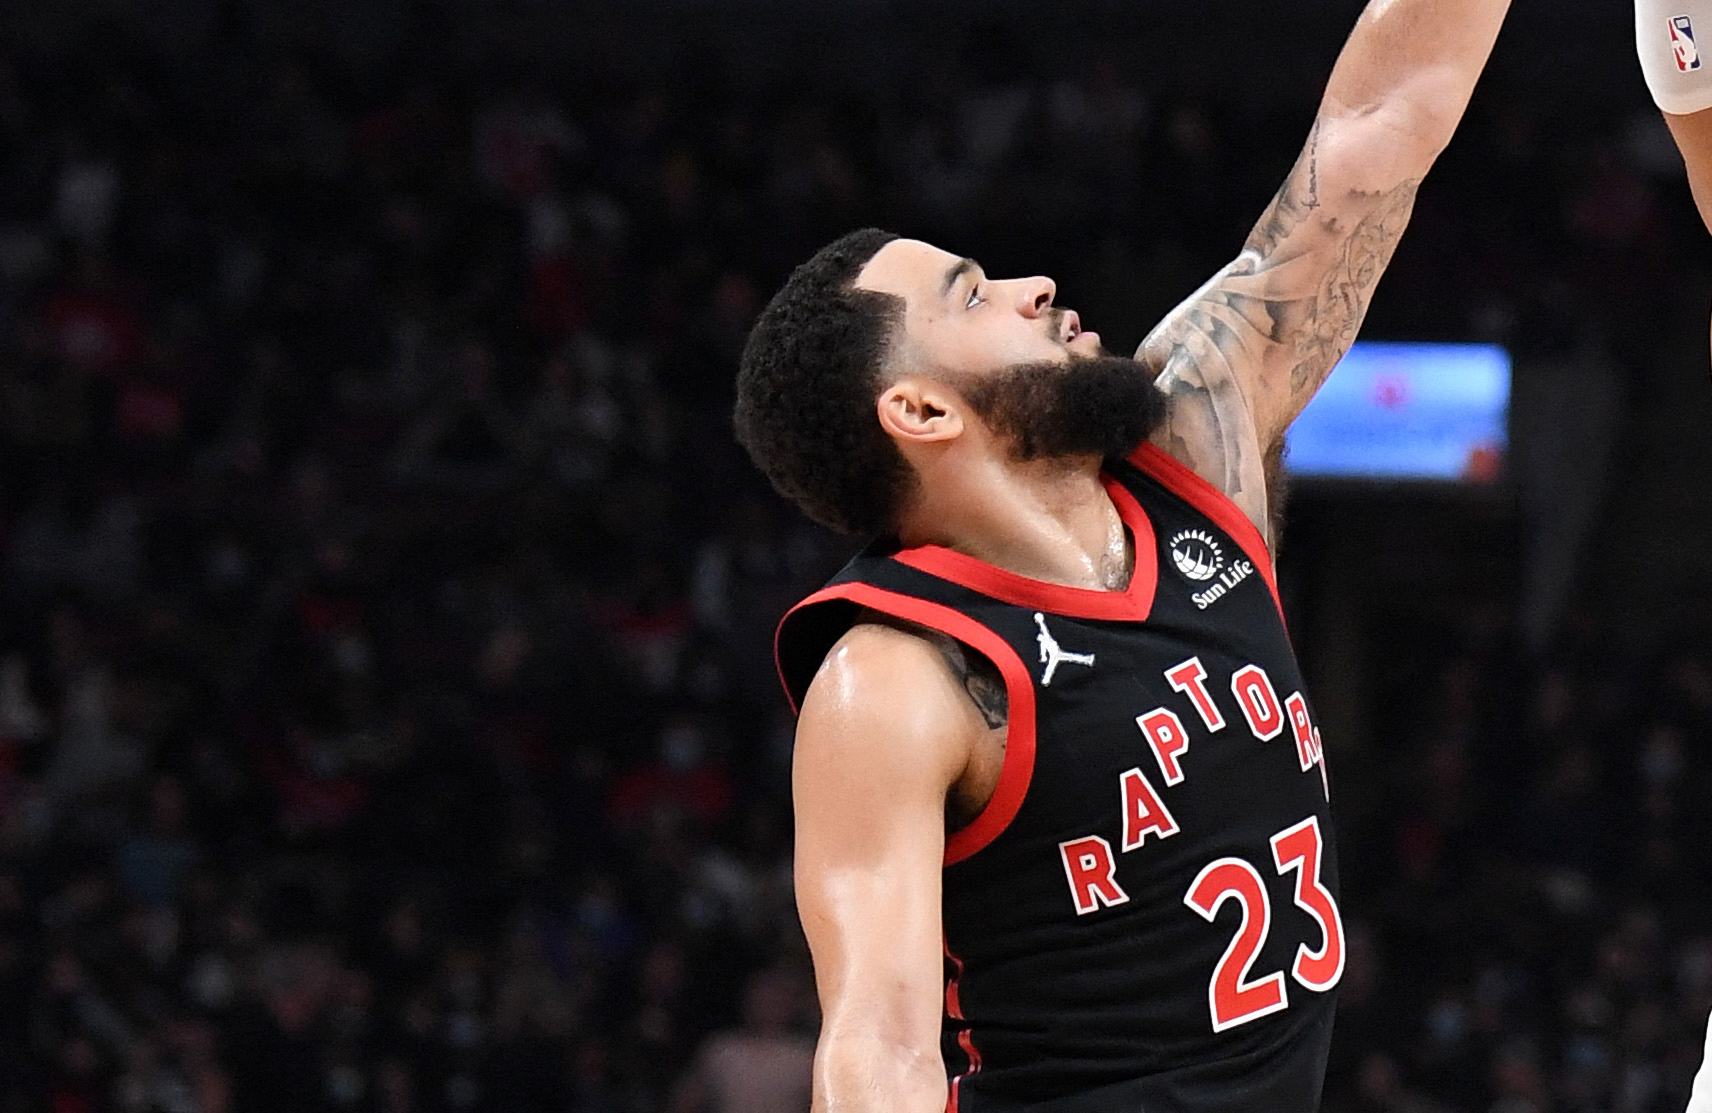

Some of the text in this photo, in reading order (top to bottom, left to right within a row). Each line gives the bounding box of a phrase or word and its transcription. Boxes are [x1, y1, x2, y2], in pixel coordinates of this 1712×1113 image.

[1191, 559, 1254, 610] Sun Life
[1184, 815, 1346, 1033] 23
